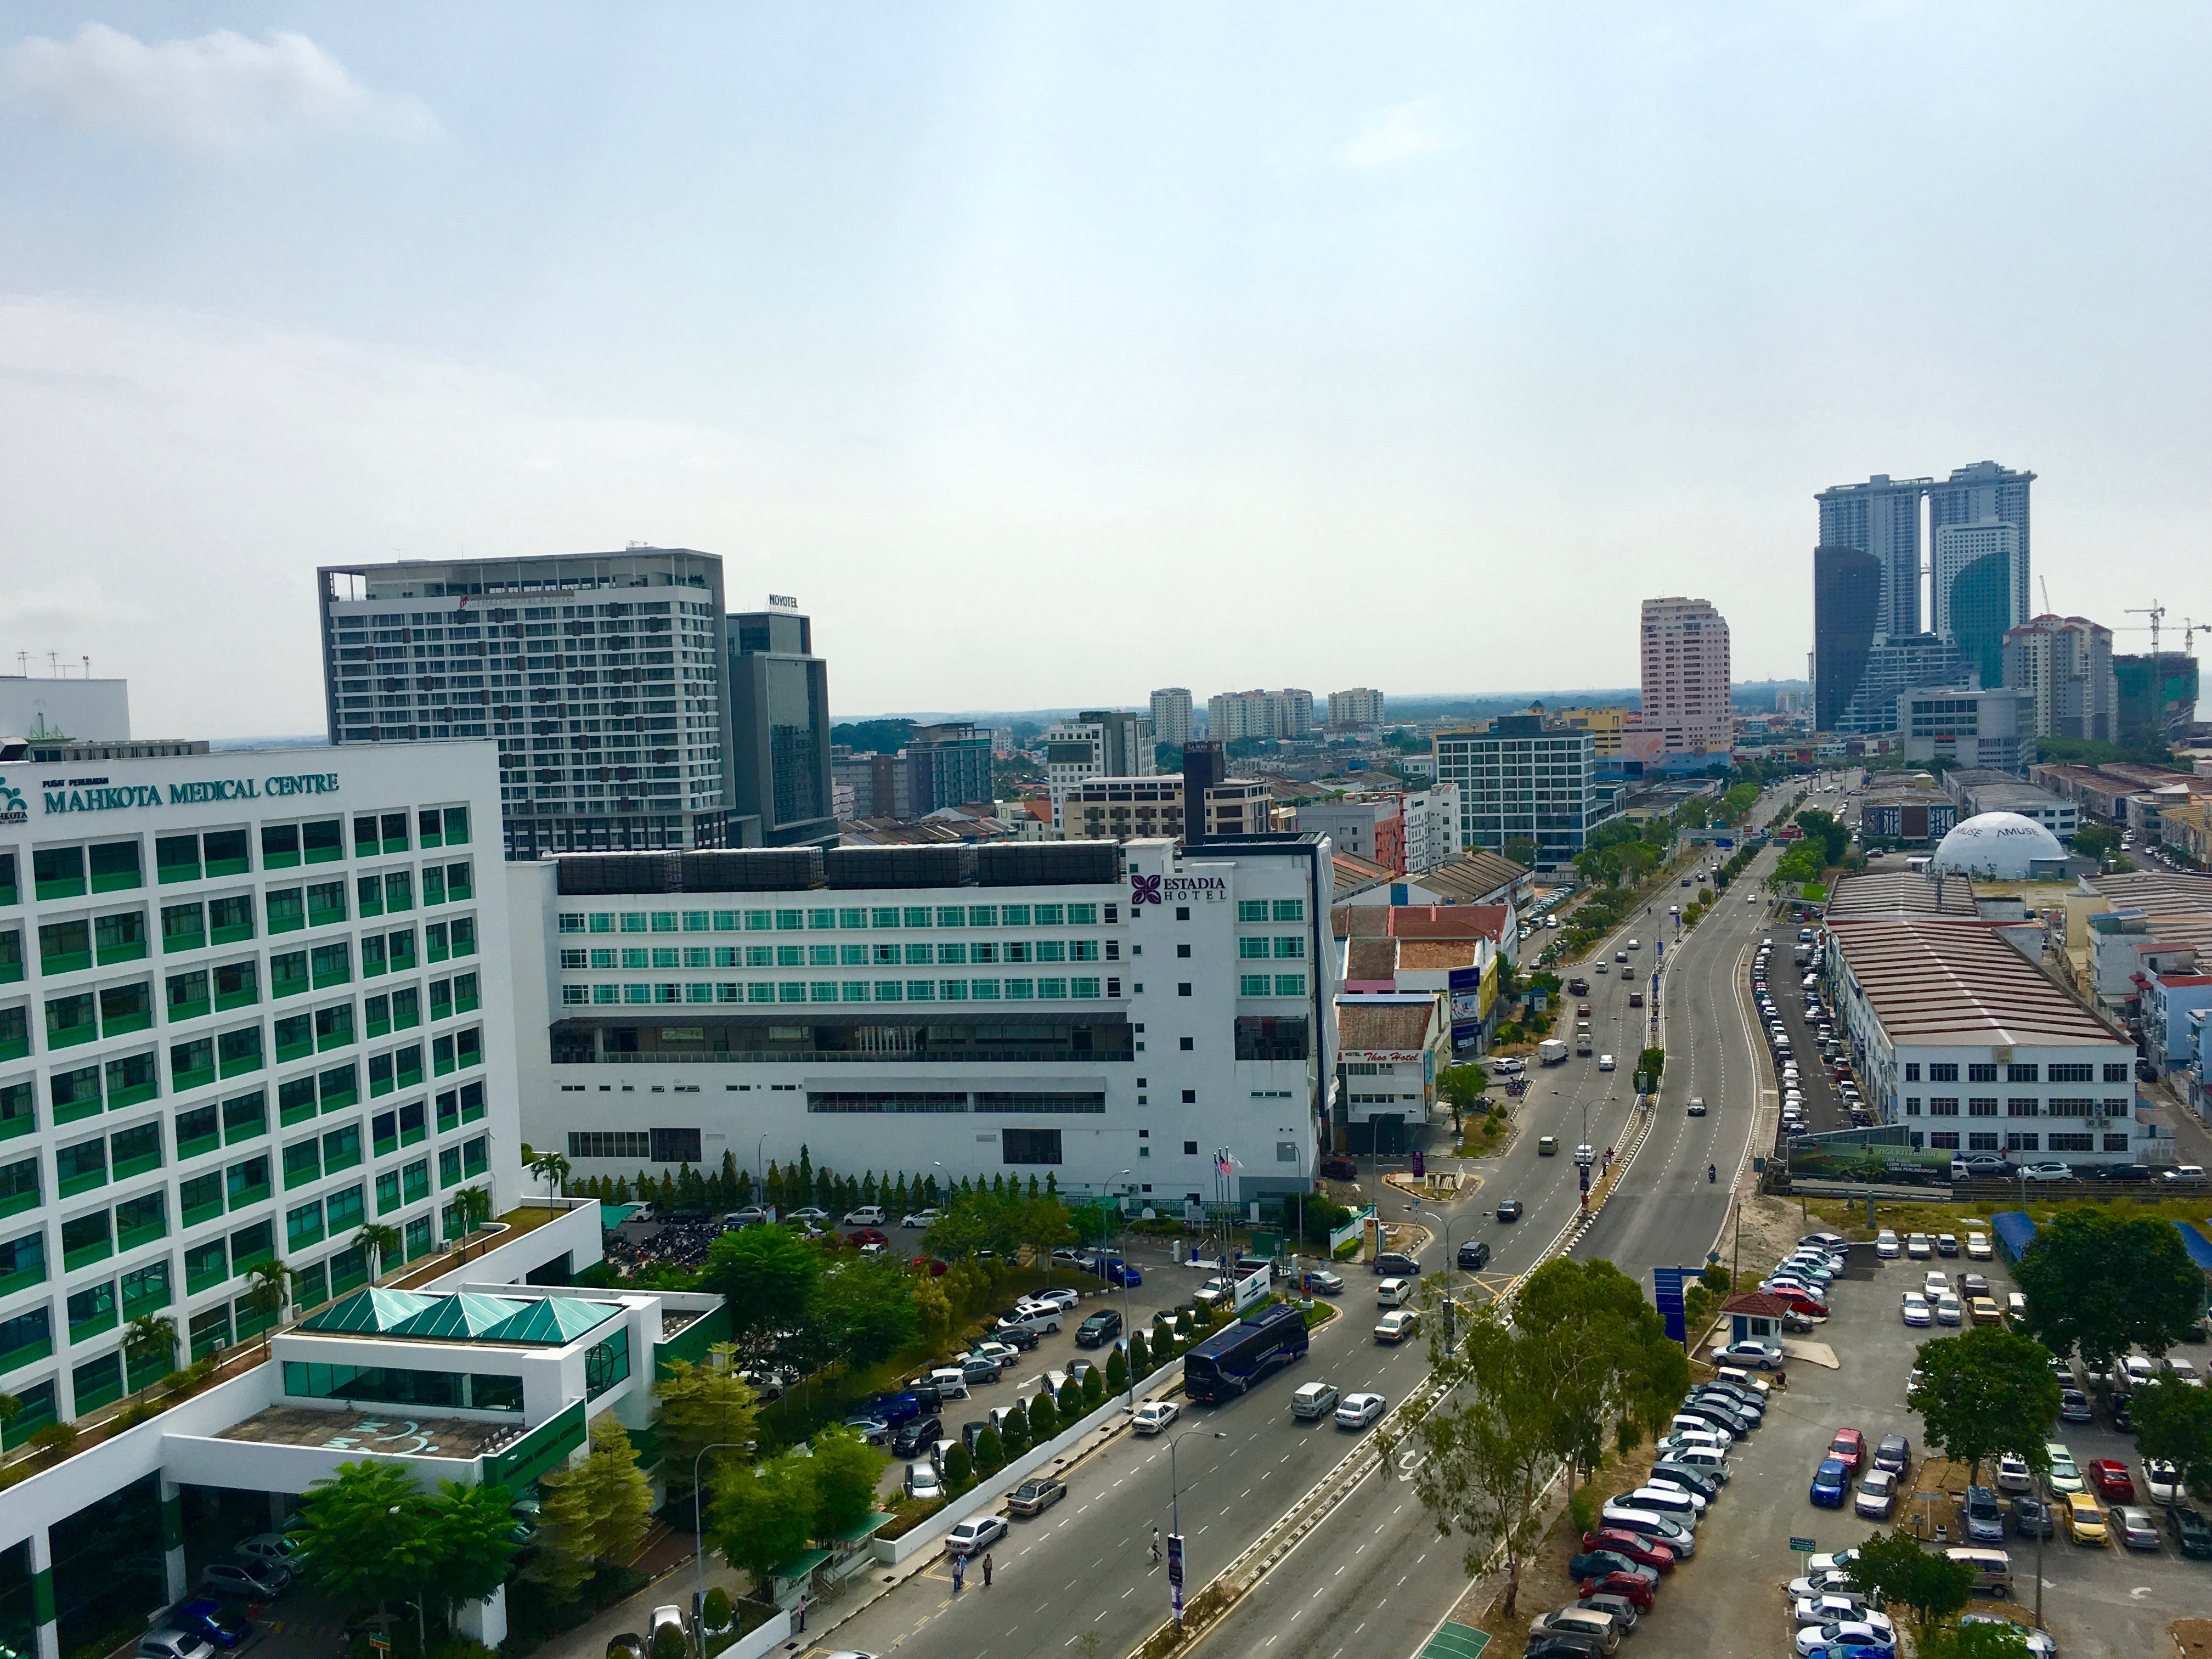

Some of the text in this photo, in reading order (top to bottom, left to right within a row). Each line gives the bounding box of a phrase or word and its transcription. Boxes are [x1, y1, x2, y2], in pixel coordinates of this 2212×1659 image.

[769, 594, 798, 608] NOVOTEL
[43, 780, 65, 788] PUSAT
[44, 773, 339, 814] MAHKOTA MEDICAL CENTRE
[1997, 827, 2039, 837] AMUSE
[1164, 877, 1226, 890] ESTADIA
[1164, 890, 1226, 900] HOTEL
[1364, 1052, 1387, 1062] Thoo
[1390, 1052, 1419, 1061] Hotel
